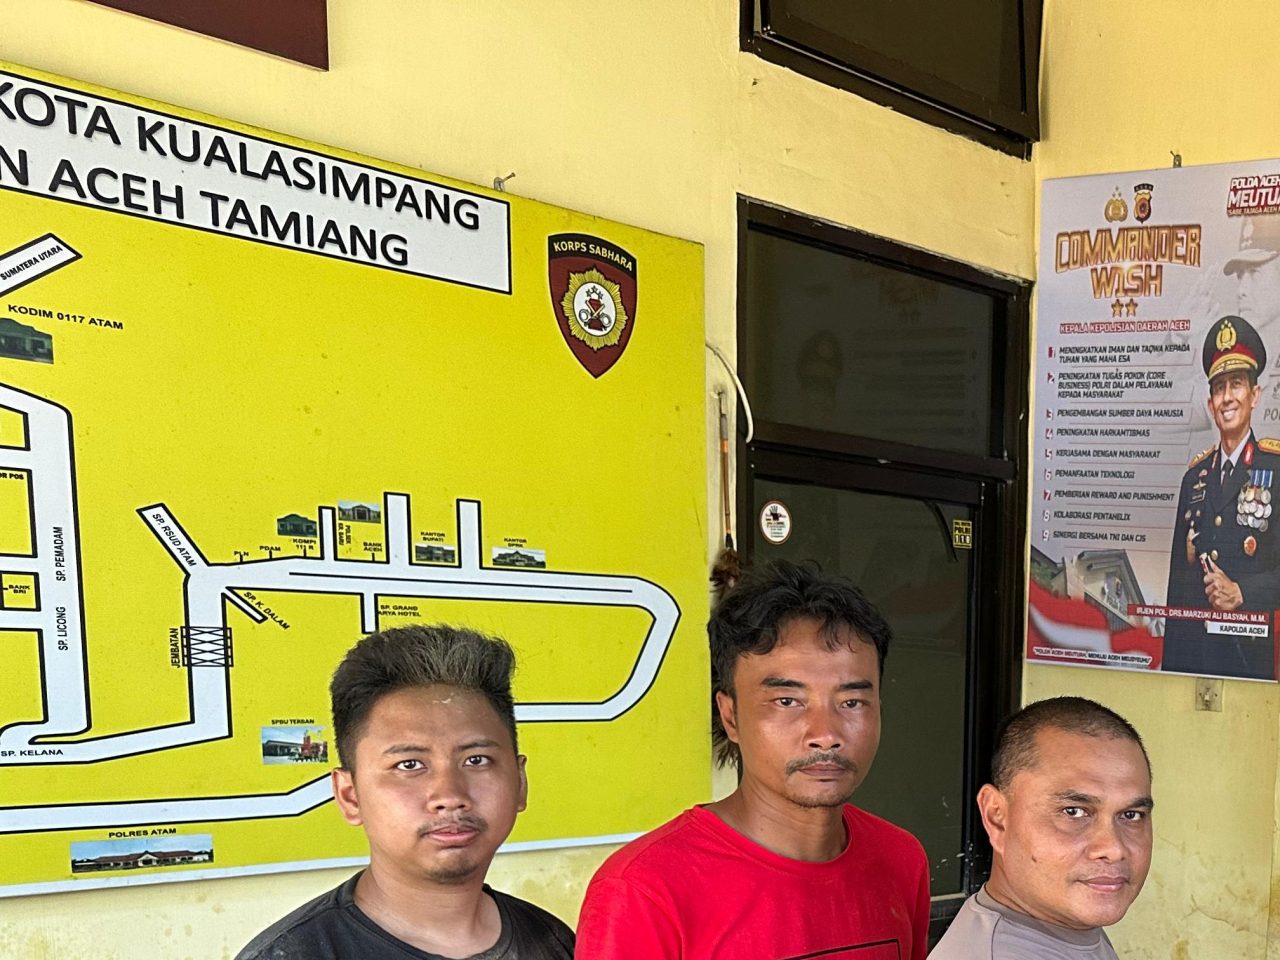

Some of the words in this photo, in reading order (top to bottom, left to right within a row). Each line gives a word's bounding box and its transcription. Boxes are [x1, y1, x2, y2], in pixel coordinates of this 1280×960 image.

[138, 116, 480, 231] KUALASIMPANG
[1230, 176, 1259, 189] POLDA
[49, 159, 185, 220] ACEH
[200, 189, 409, 267] TAMIANG
[0, 257, 39, 280] SUMATERA
[39, 245, 63, 263] UTARA
[553, 241, 587, 252] KORPS
[589, 244, 633, 272] SABHARA
[1056, 224, 1201, 273] COMMANDER
[1091, 263, 1162, 299] WISH
[8, 304, 53, 319] KODIM
[57, 312, 85, 324] 0117
[88, 317, 124, 330] ATAM
[1060, 322, 1088, 334] KEPALA
[1090, 321, 1135, 333] KEPOLISIAN
[1137, 320, 1169, 332] DAERAH
[1169, 319, 1190, 331] ACEH
[53, 526, 66, 567] PEMADAM
[152, 513, 164, 526] SP.
[162, 525, 181, 547] RSUD
[177, 546, 198, 567] ATAM
[56, 568, 66, 582] SP.
[56, 606, 68, 638] LICONG
[244, 591, 256, 603] SP.
[263, 608, 290, 630] DALAM
[58, 638, 68, 651] SP.
[1220, 624, 1247, 634] KAPOLDA
[1248, 626, 1265, 635] ACEH
[169, 628, 181, 668] JEMBATAN
[108, 829, 149, 838] POLRES
[151, 828, 177, 837] ATAM
